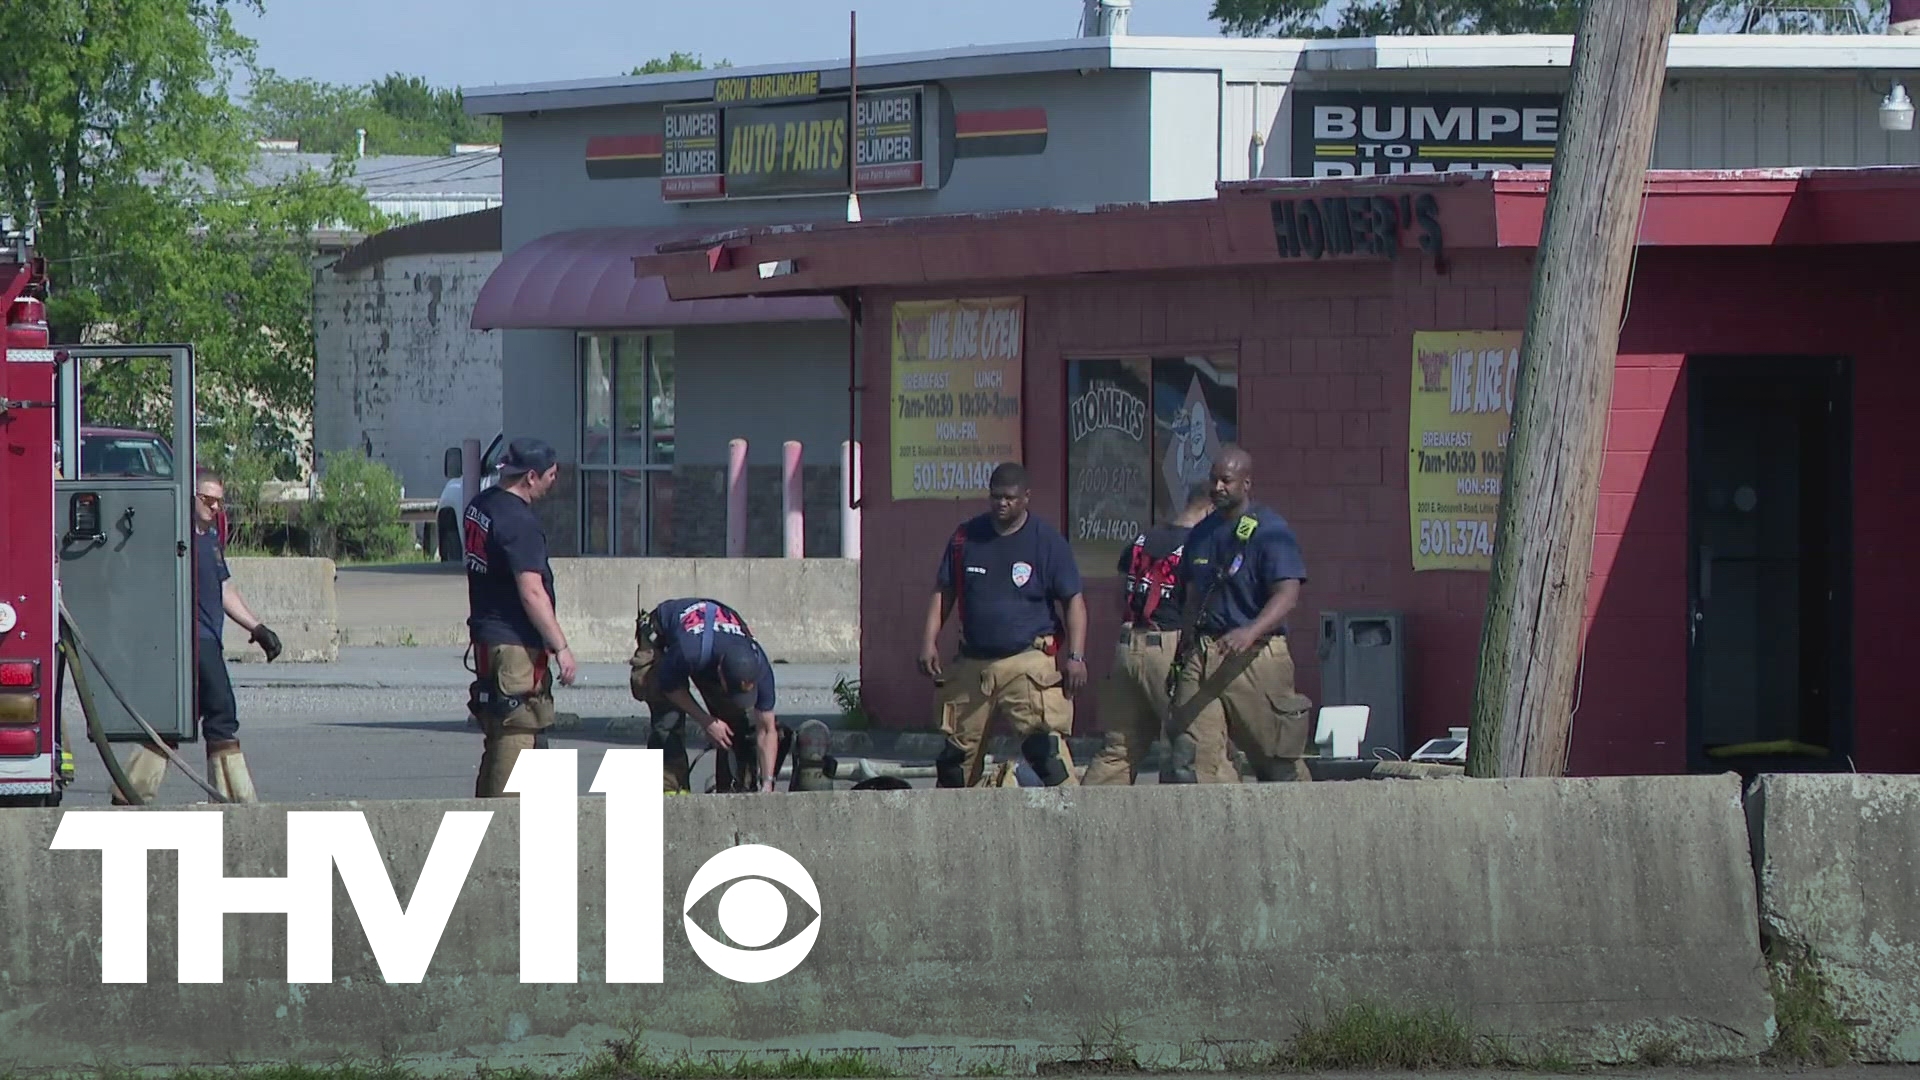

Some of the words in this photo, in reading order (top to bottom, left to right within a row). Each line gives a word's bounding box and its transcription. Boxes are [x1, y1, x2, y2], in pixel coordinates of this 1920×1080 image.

[716, 78, 748, 102] CROW
[750, 72, 819, 99] BURLINGAME
[857, 98, 911, 125] BUMPER
[1313, 105, 1559, 141] BUMPE
[665, 113, 716, 138] BUMPER
[865, 126, 876, 137] TO
[728, 122, 777, 175] AUTO
[781, 118, 845, 172] PARTS
[857, 136, 911, 163] BUMPER
[1357, 144, 1412, 158] TO
[665, 150, 716, 174] BUMPER
[1270, 192, 1444, 261] HOMER'S
[928, 309, 950, 360] WE
[951, 308, 979, 360] ARE
[981, 305, 1019, 360] OPEN
[903, 371, 950, 390] BREAKFAST
[974, 368, 1003, 389] LUNCH
[1450, 347, 1474, 415] WE
[1473, 347, 1504, 415] ARE
[1071, 387, 1146, 442] HOMER'S
[1422, 431, 1472, 447] BREAKFAST
[1418, 450, 1476, 474] 7am-10:30
[1079, 516, 1138, 540] 374-1400
[1419, 519, 1497, 556] 501.374.
